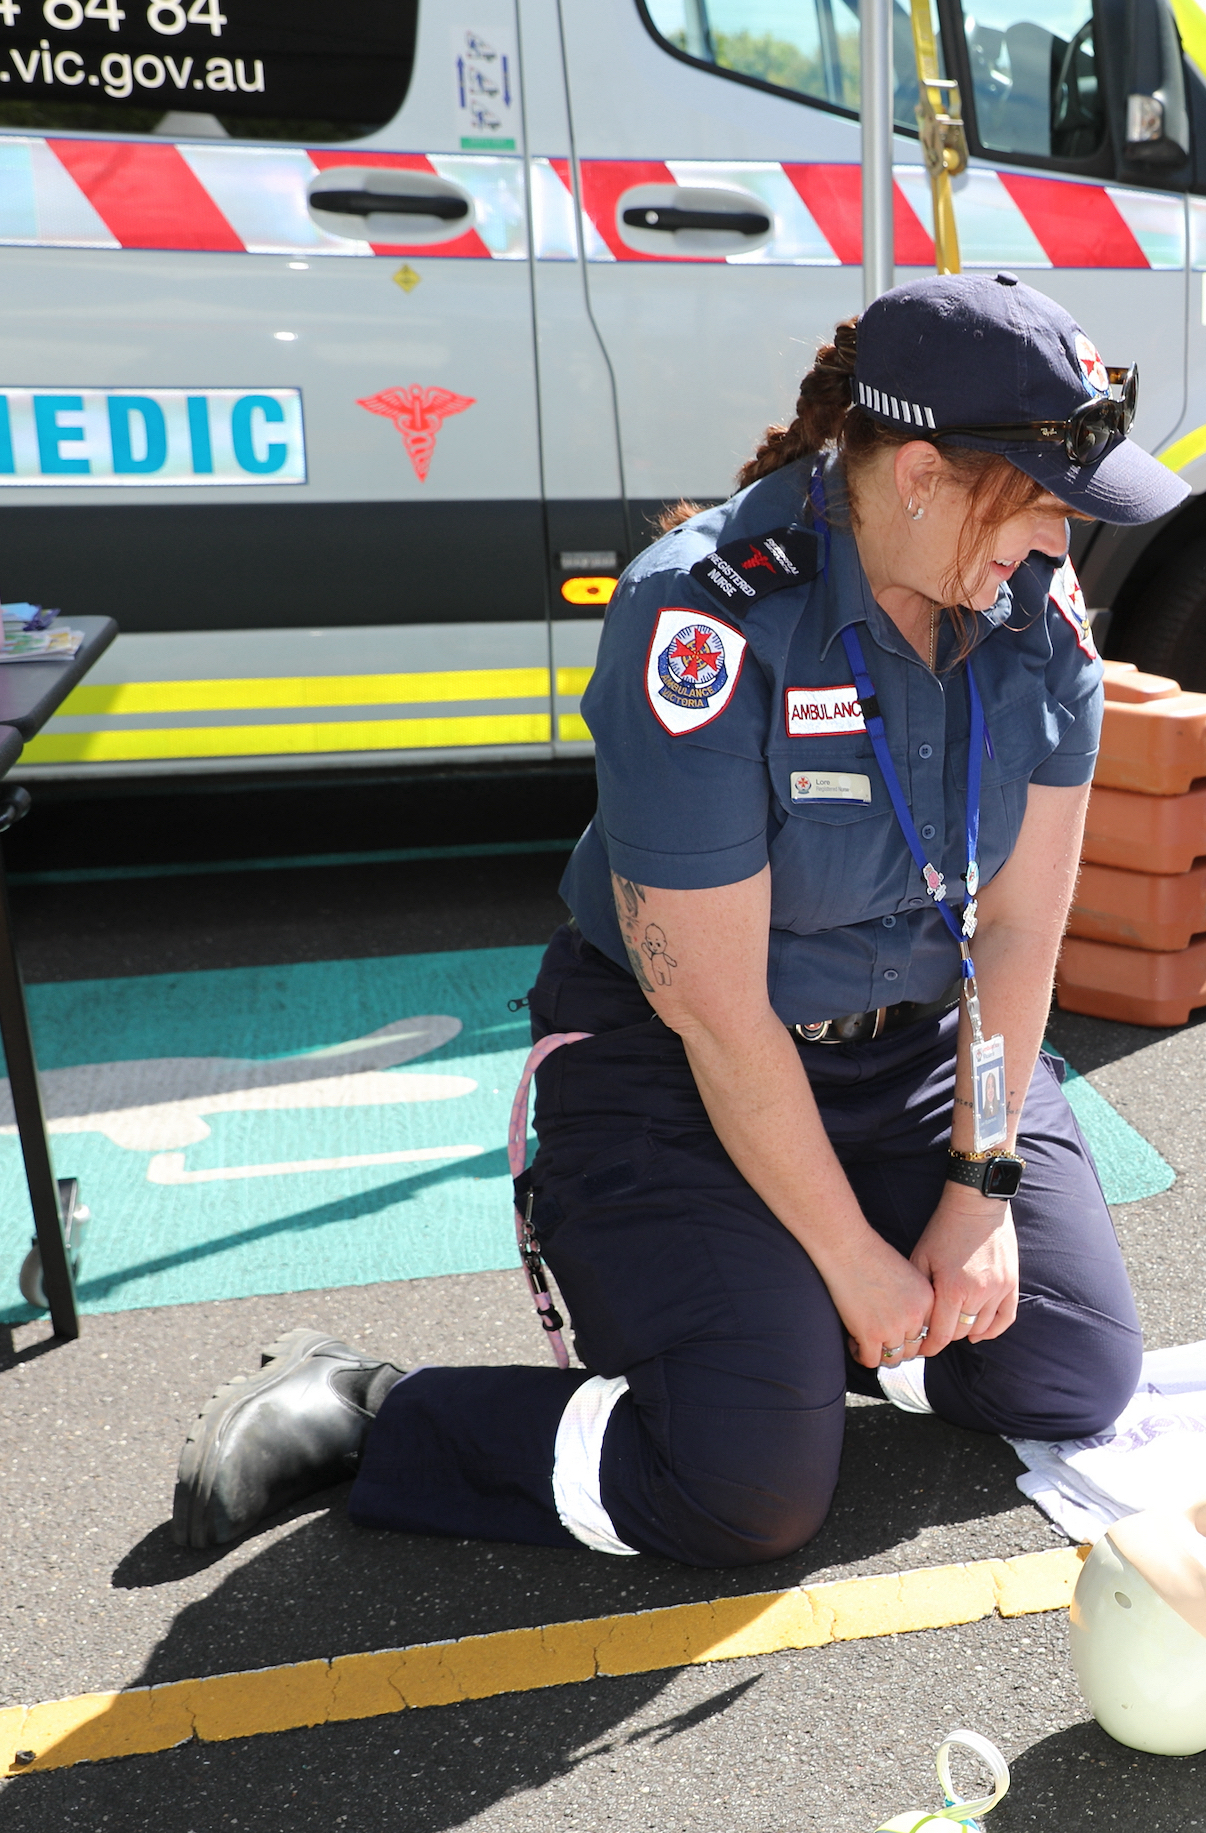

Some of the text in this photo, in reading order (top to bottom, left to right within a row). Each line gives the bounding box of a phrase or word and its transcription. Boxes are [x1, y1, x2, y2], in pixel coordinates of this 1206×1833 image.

[0, 39, 265, 98] .vic.gov.au
[0, 394, 288, 475] EDIC
[707, 552, 757, 597] REGISTERED
[707, 568, 738, 598] NURSE
[660, 674, 715, 698] AMBULANCE
[661, 688, 705, 708] VICTORIA
[791, 700, 862, 721] AMBULANC
[815, 778, 831, 786] Lore
